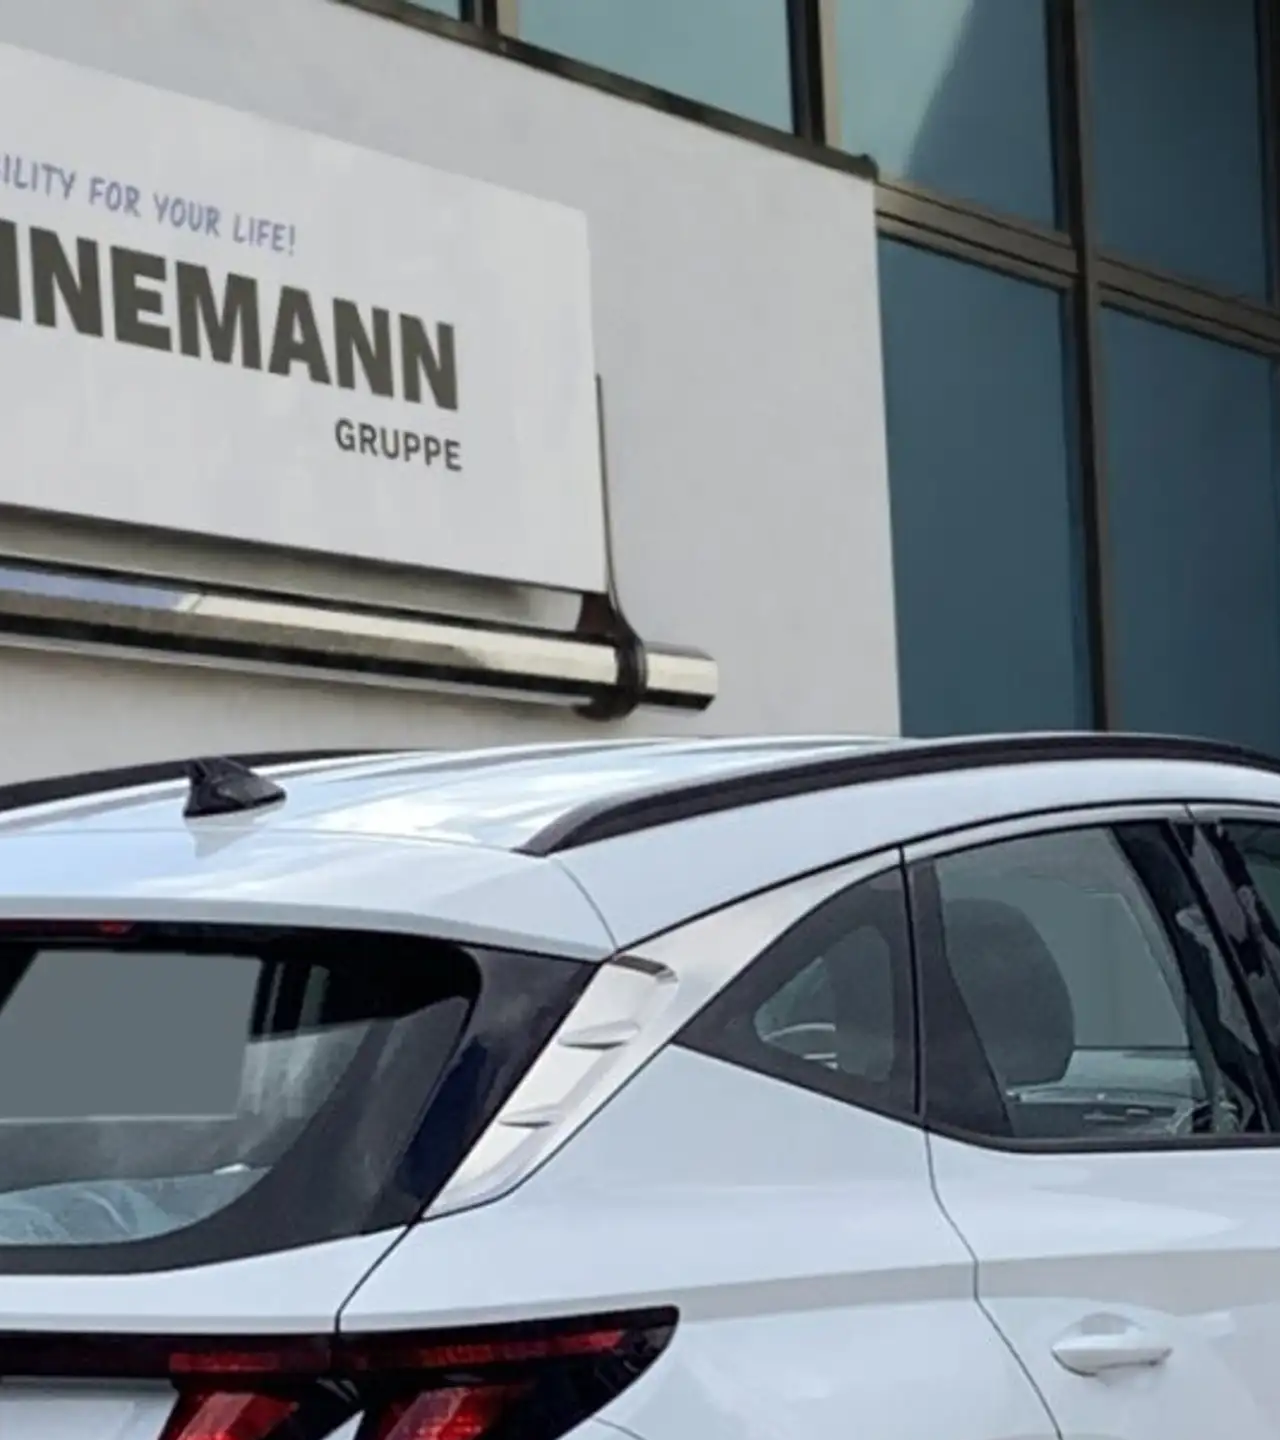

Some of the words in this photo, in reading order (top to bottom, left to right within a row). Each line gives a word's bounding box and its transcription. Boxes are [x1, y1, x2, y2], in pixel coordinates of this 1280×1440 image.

[88, 176, 141, 217] FOR
[152, 193, 222, 238] YOUR
[233, 214, 297, 256] LIFE!
[335, 419, 461, 471] GRUPPE
